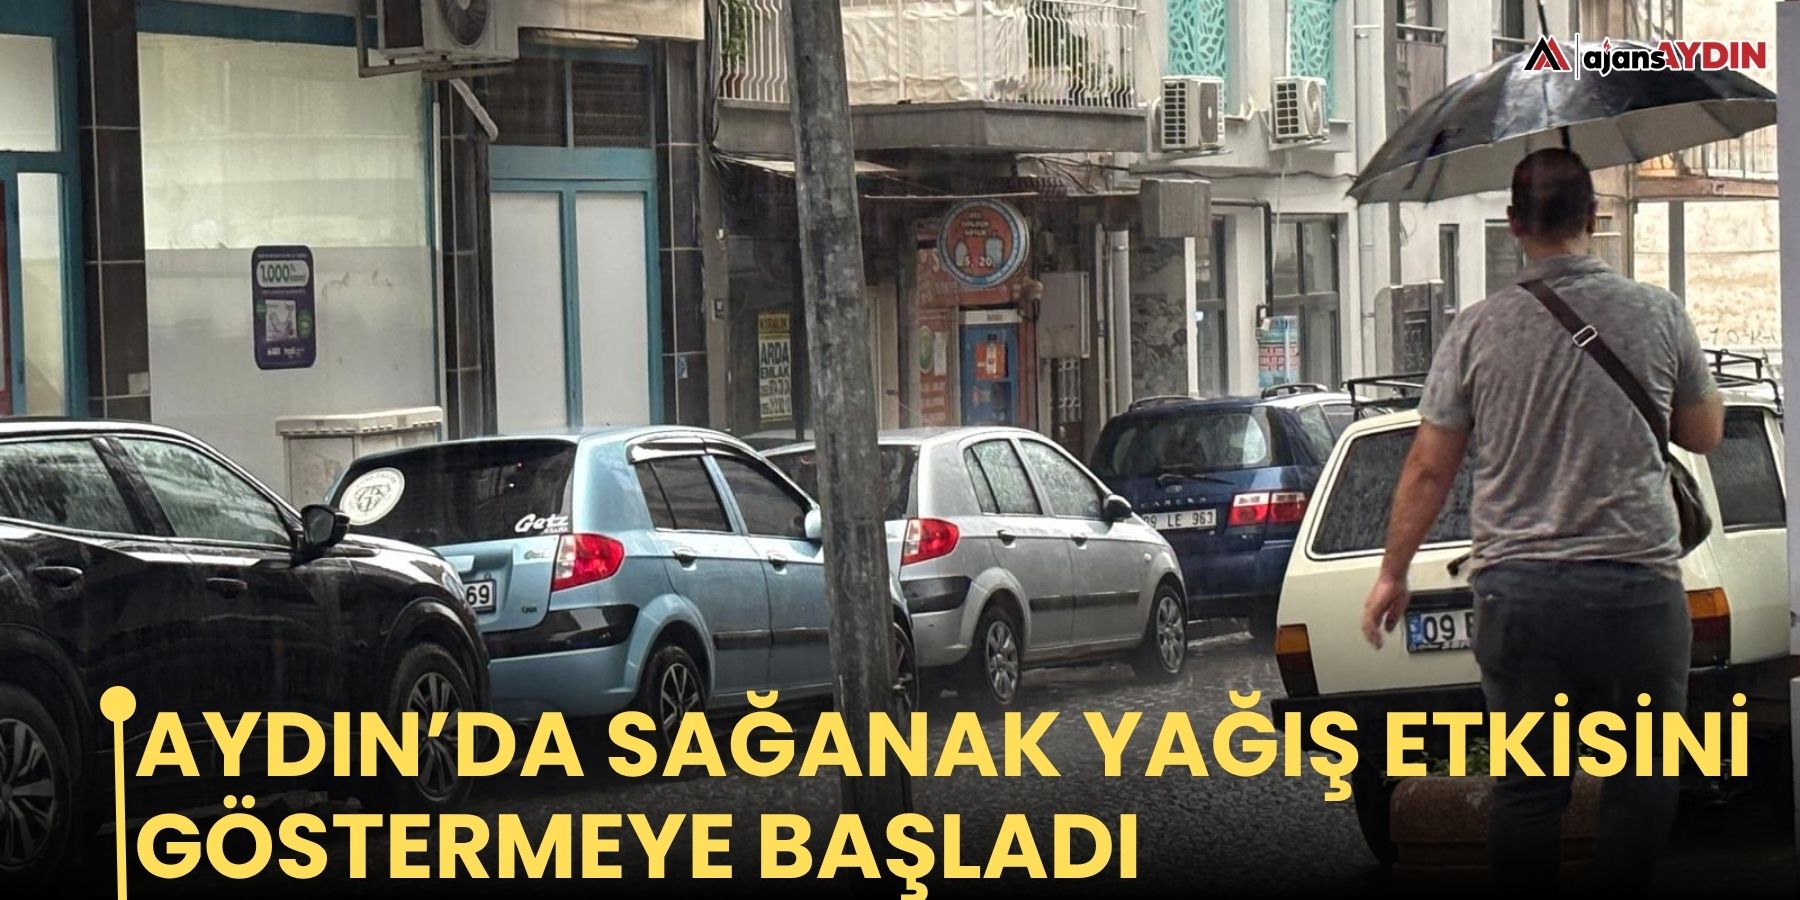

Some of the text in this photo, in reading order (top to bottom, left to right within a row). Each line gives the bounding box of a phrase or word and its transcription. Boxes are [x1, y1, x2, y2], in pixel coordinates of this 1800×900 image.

[761, 341, 790, 366] ARDA
[760, 365, 790, 380] EMLAK
[514, 513, 569, 533] Getz
[1167, 513, 1182, 527] LE
[1191, 511, 1214, 526] 963
[1423, 614, 1456, 643] 09
